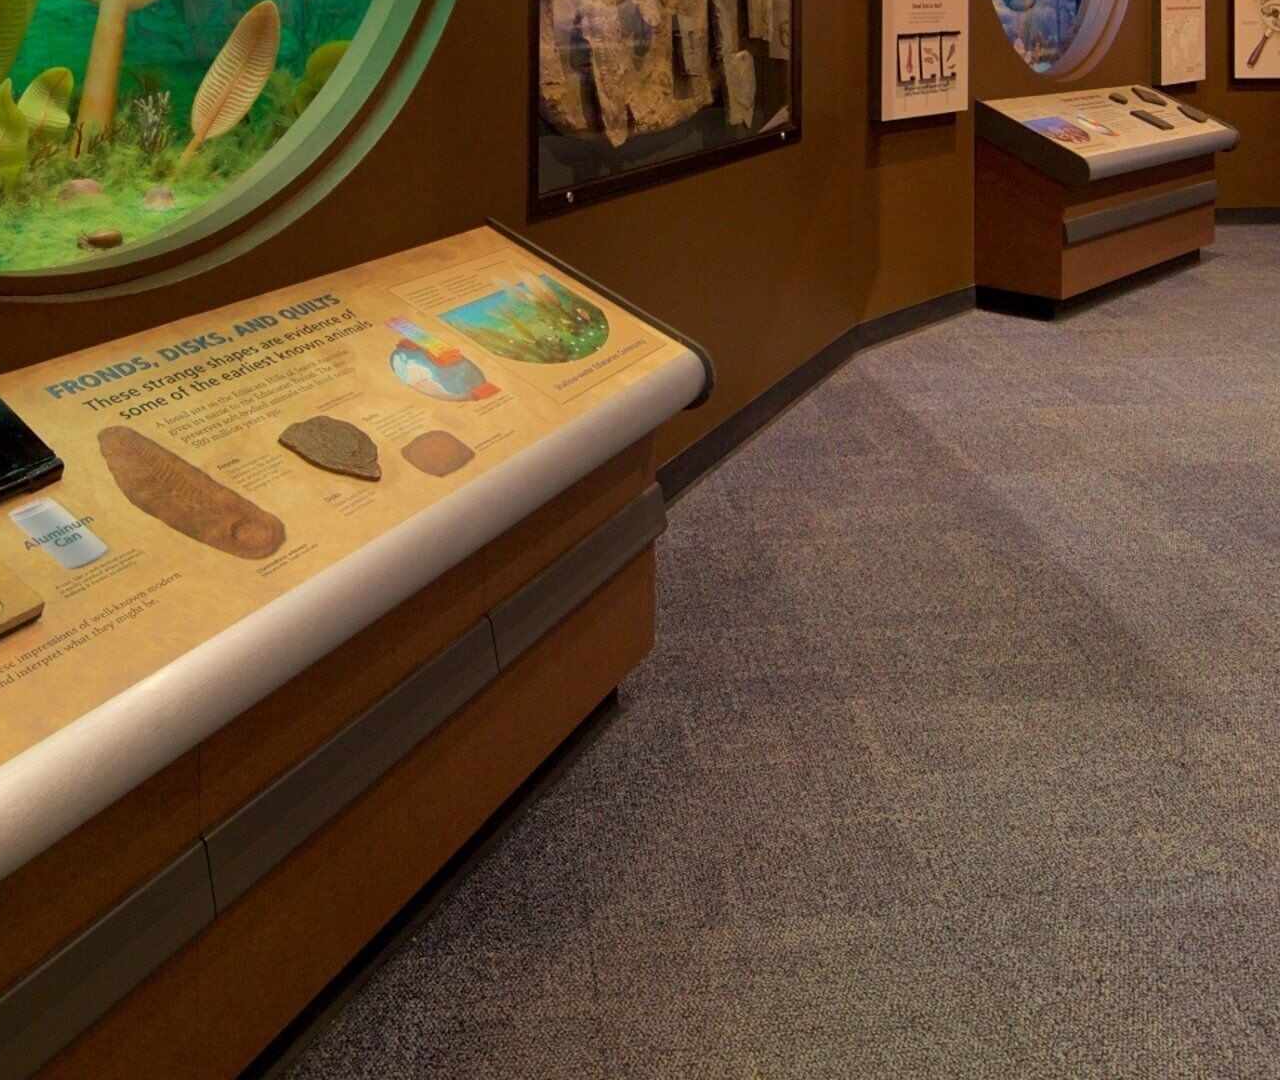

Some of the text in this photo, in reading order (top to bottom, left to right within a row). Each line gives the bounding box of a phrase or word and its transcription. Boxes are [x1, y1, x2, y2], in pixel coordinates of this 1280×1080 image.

[44, 293, 341, 400] FRONDS, DISKS, AND QUILTS
[82, 309, 357, 413] These strange shapes are evidence of
[119, 396, 169, 420] some
[170, 385, 190, 401] of
[189, 377, 221, 392] the
[221, 354, 278, 382] earliest
[273, 338, 326, 362] known
[324, 320, 373, 343] animals
[155, 411, 191, 429] A fossil
[168, 422, 192, 438] gives
[205, 407, 231, 420] name
[180, 422, 223, 443] preserves
[210, 414, 267, 441] million years
[24, 515, 95, 551] Aluminum
[53, 532, 83, 548] Can
[16, 627, 78, 665] impressions
[79, 619, 91, 630] of
[90, 591, 147, 623] well-known
[147, 572, 182, 593] modern
[15, 649, 64, 681] interpret
[63, 634, 92, 652] what
[91, 620, 115, 637] they
[115, 605, 145, 624] might
[142, 598, 160, 608] be.
